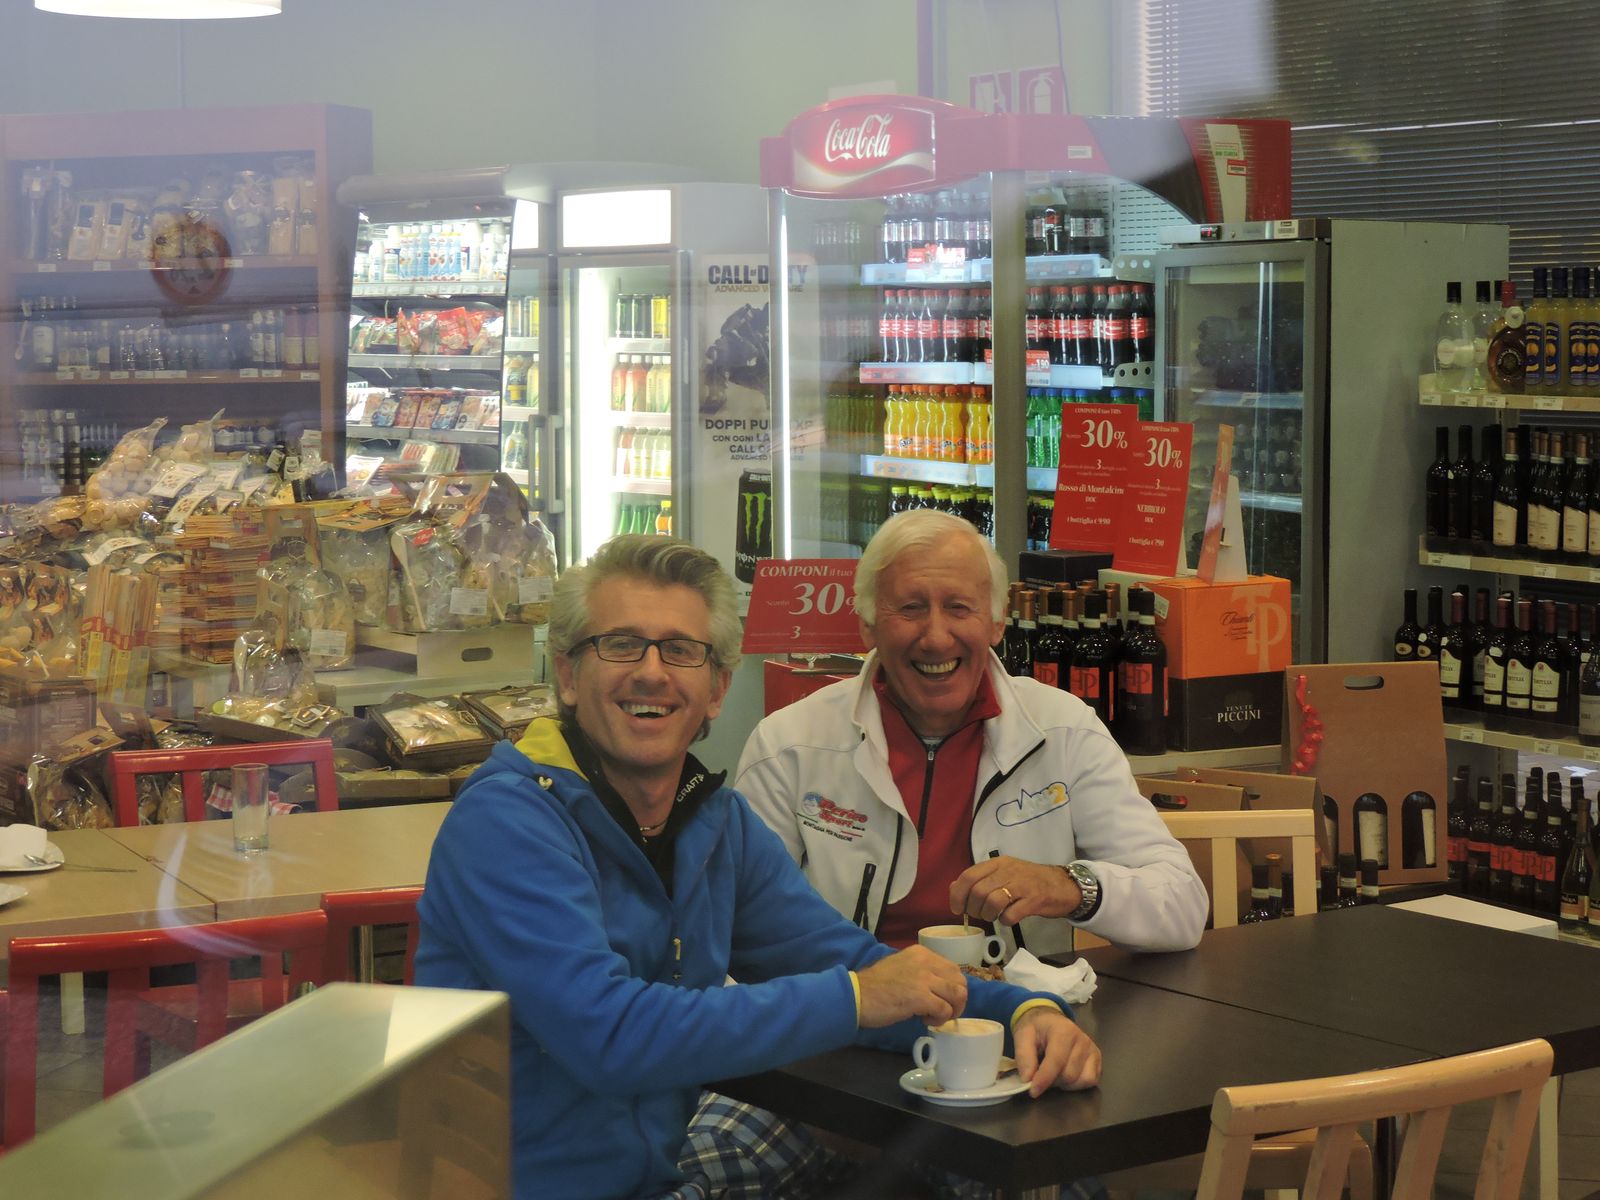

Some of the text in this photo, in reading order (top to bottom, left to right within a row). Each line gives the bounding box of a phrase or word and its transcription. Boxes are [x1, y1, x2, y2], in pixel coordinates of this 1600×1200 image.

[825, 113, 894, 162] Coca-Cola
[708, 265, 752, 285] CALL
[715, 285, 760, 293] ADVANCED
[705, 419, 746, 430] DOPPI
[712, 434, 731, 443] CON
[732, 434, 754, 443] OGNI
[1080, 419, 1128, 449] 30%
[729, 444, 756, 454] CALL
[1143, 437, 1183, 469] 30%
[1095, 458, 1102, 470] 3
[1058, 483, 1078, 492] Rosso
[1155, 478, 1161, 490] 3
[760, 565, 830, 578] COMPONI
[830, 568, 836, 577] il
[835, 568, 853, 577] tuo
[790, 625, 801, 639] 3
[1226, 704, 1253, 712] TENUTE
[1217, 709, 1261, 723] PICCINI
